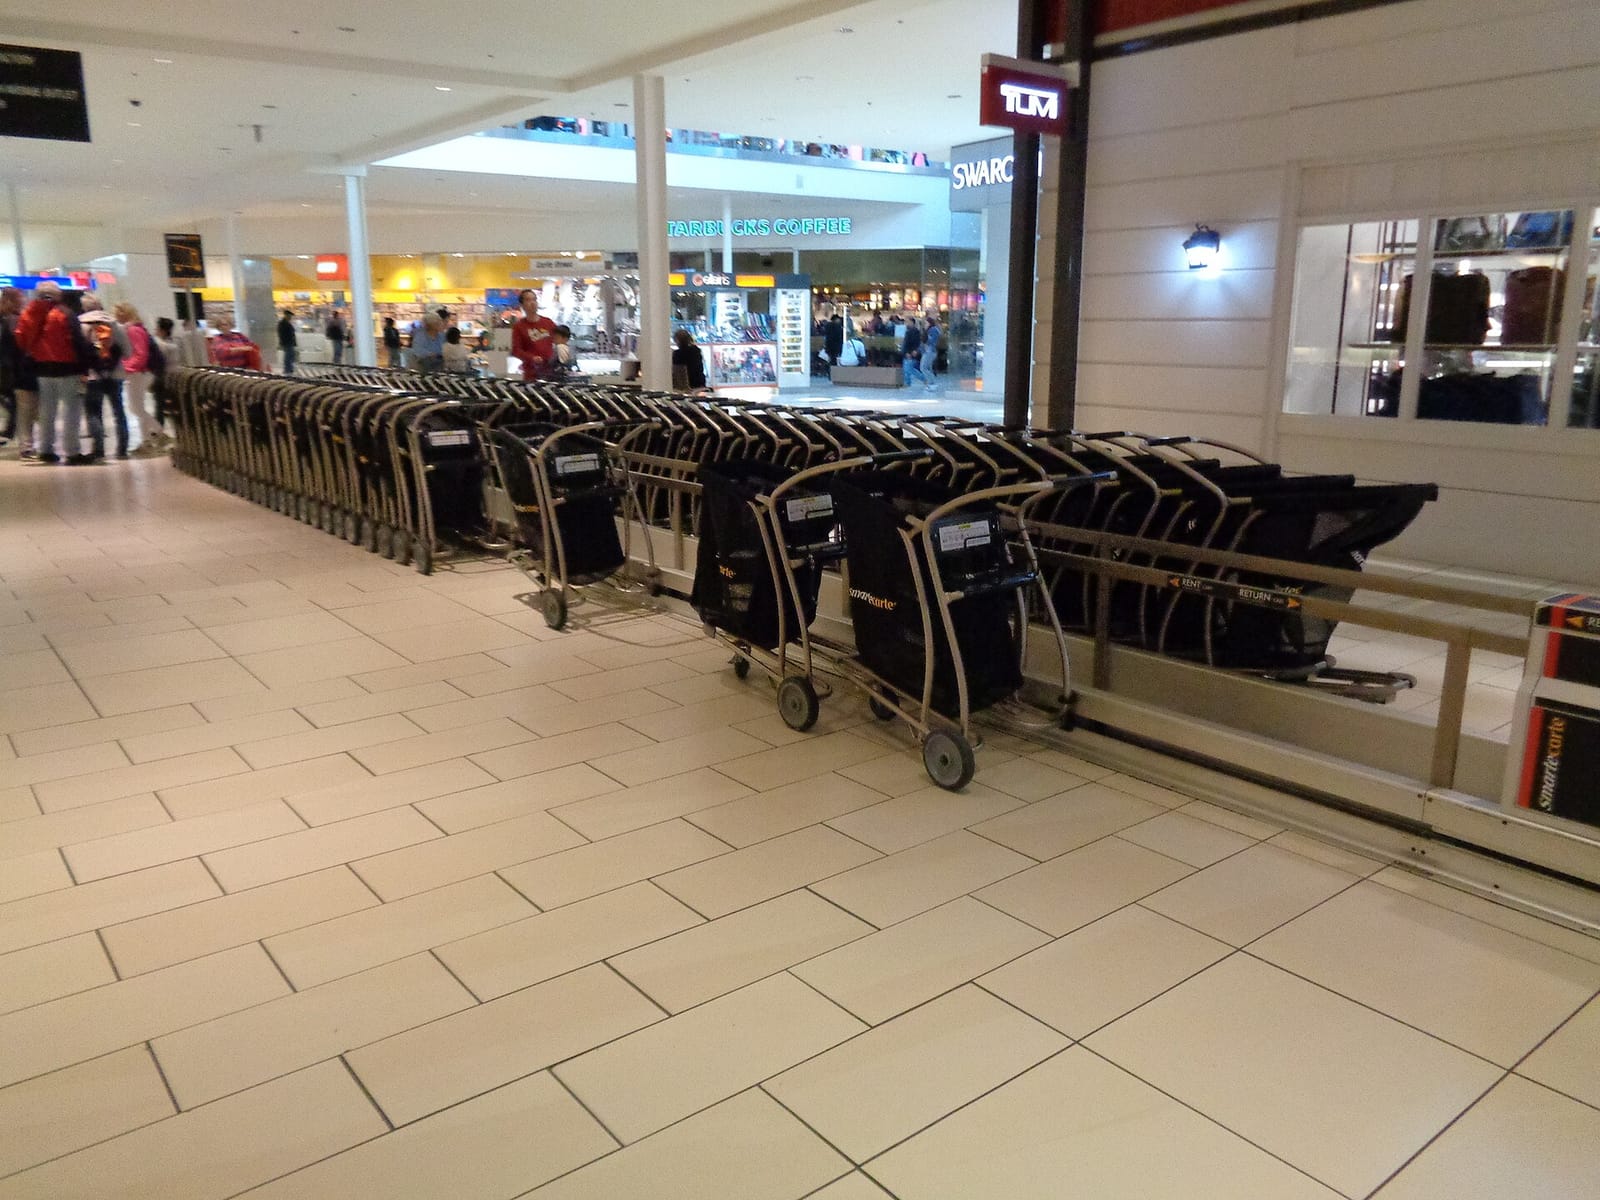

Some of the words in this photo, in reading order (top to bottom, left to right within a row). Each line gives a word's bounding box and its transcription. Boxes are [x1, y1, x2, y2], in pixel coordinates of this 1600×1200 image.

[667, 218, 771, 238] TARBUCKS
[773, 217, 852, 236] COFFEE
[1239, 588, 1272, 602] RETURN
[1588, 616, 1600, 628] RE
